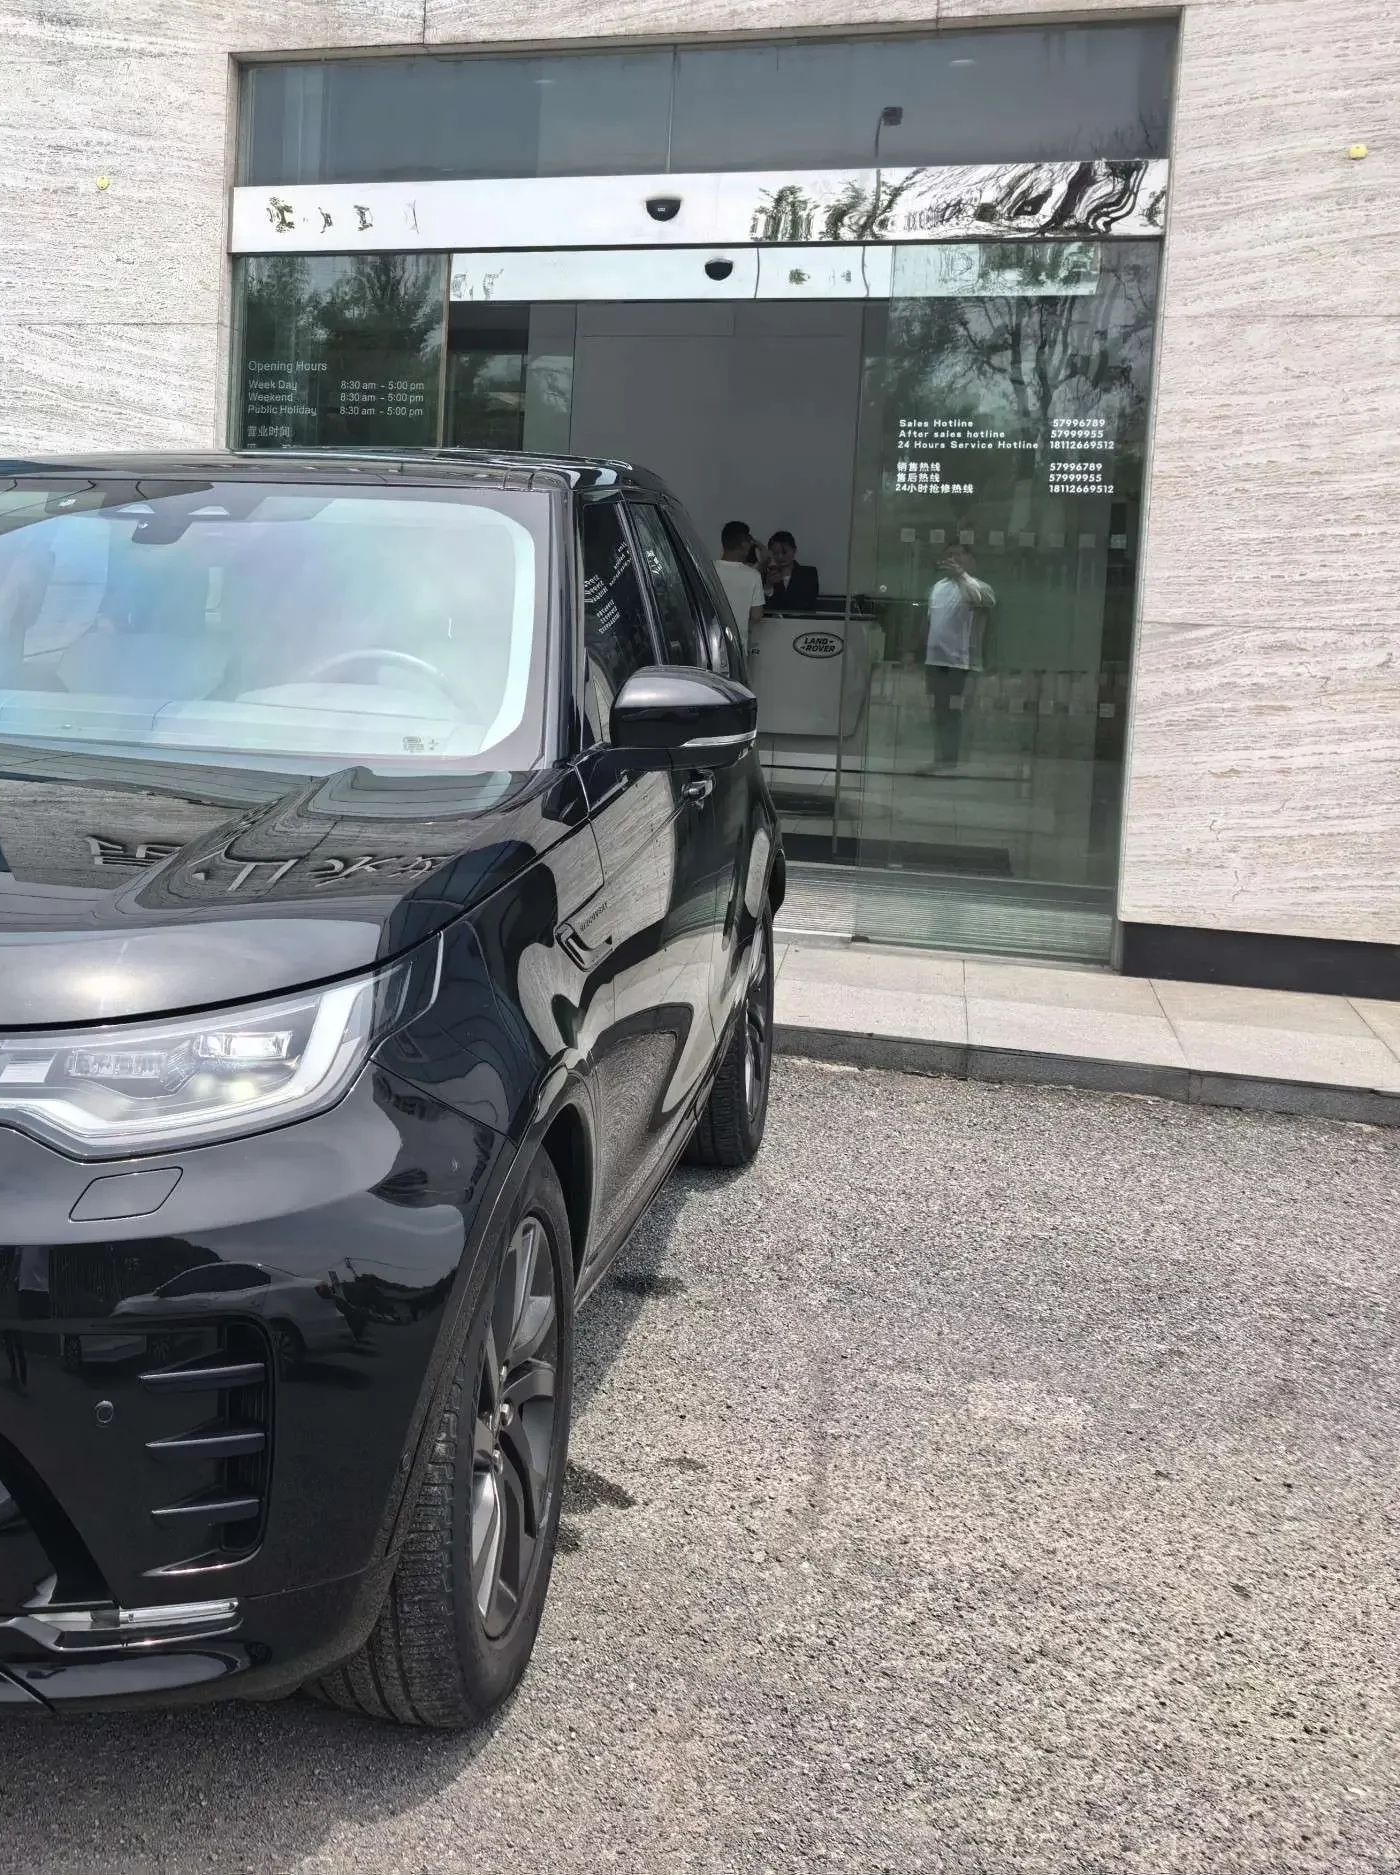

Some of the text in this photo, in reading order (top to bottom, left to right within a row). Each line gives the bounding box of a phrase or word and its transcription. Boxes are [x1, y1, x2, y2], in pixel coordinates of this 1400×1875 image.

[248, 361, 328, 373] Opening Hours
[249, 380, 276, 389] Week
[279, 380, 298, 391] Day
[340, 380, 360, 390] 8:30
[362, 382, 376, 390] am
[388, 381, 407, 390] 5:00
[409, 382, 424, 391] pm
[249, 392, 293, 402] Weekend
[409, 394, 424, 404] pm
[248, 405, 278, 414] Public
[280, 405, 317, 416] Holiday
[408, 408, 423, 417] pm
[899, 419, 1105, 427] Sales Hotline 57996789
[898, 430, 1104, 438] After sales hotline 57999955
[898, 441, 1114, 449] 24 Hours Service Hotline 18112669512
[897, 462, 1103, 472] 销售热线 57996789
[896, 473, 1102, 482] 售后热线 57999955
[1049, 485, 1114, 493] 18112669512
[804, 637, 828, 645] LAND
[805, 645, 836, 653] ROVER
